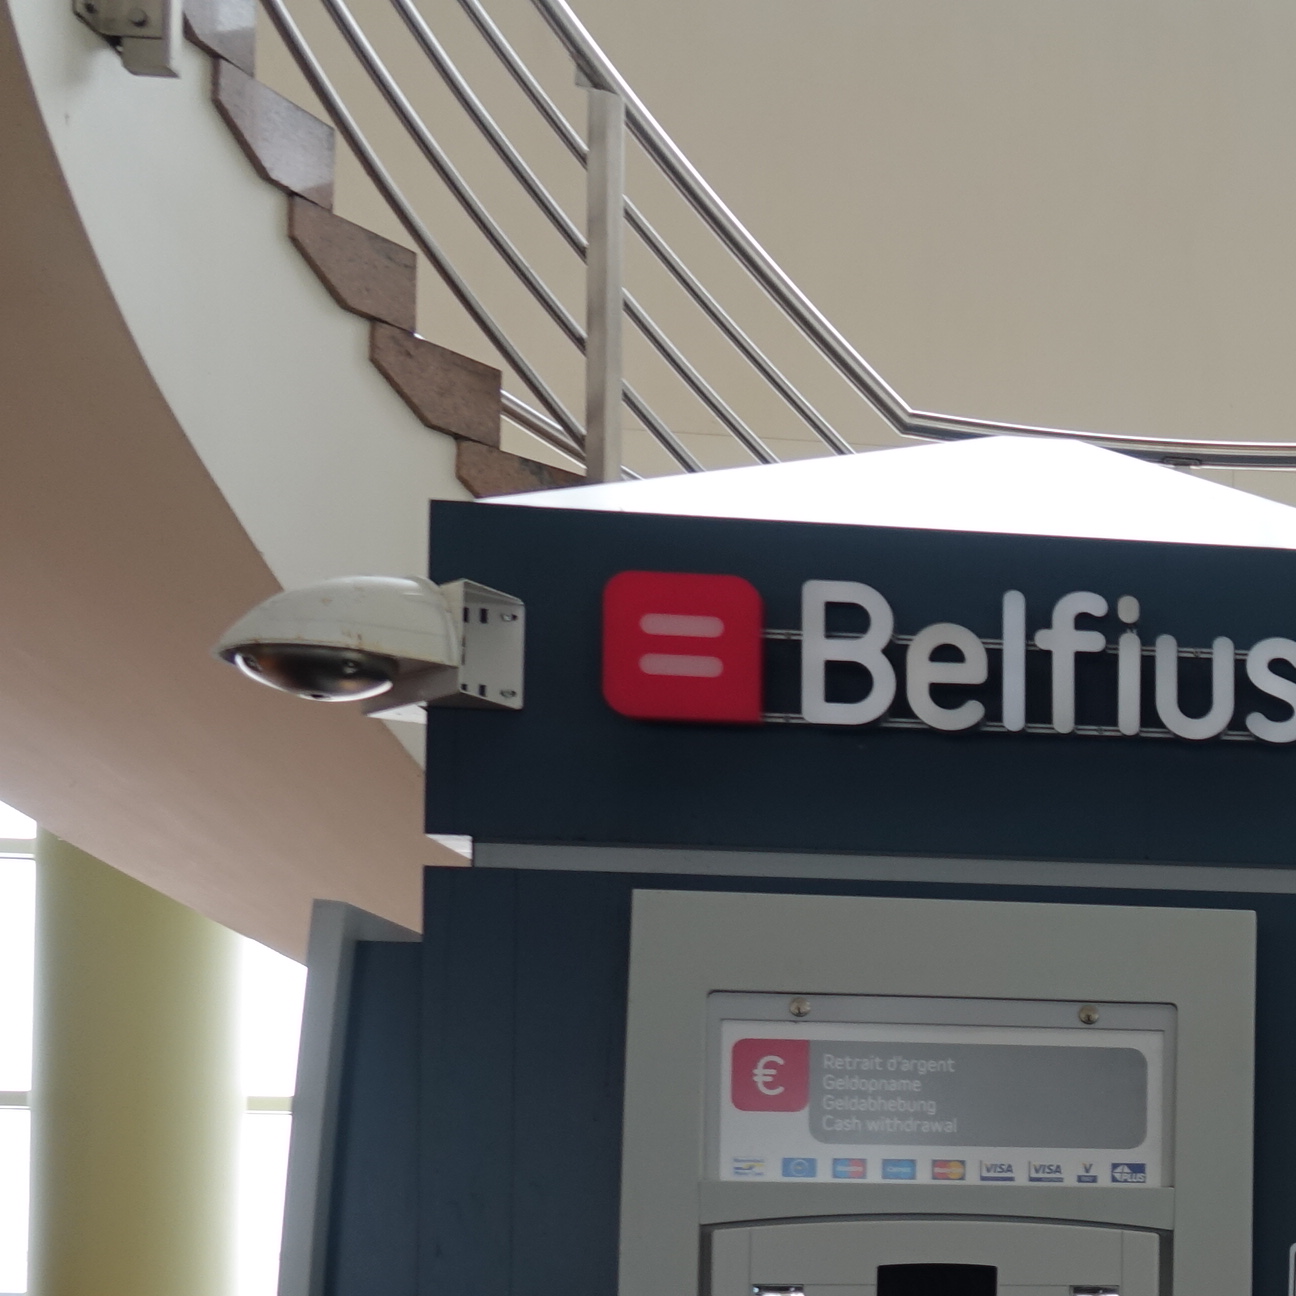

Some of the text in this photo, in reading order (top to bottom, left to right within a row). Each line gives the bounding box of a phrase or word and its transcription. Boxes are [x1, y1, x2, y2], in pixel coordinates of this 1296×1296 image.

[823, 1054, 956, 1075] Retrait d'argent
[823, 1074, 922, 1093] Geldopname
[823, 1094, 937, 1115] Geldabhebung
[822, 1115, 958, 1133] Cash withdrawal
[984, 1163, 1014, 1174] VISA
[1033, 1163, 1063, 1175] VISA
